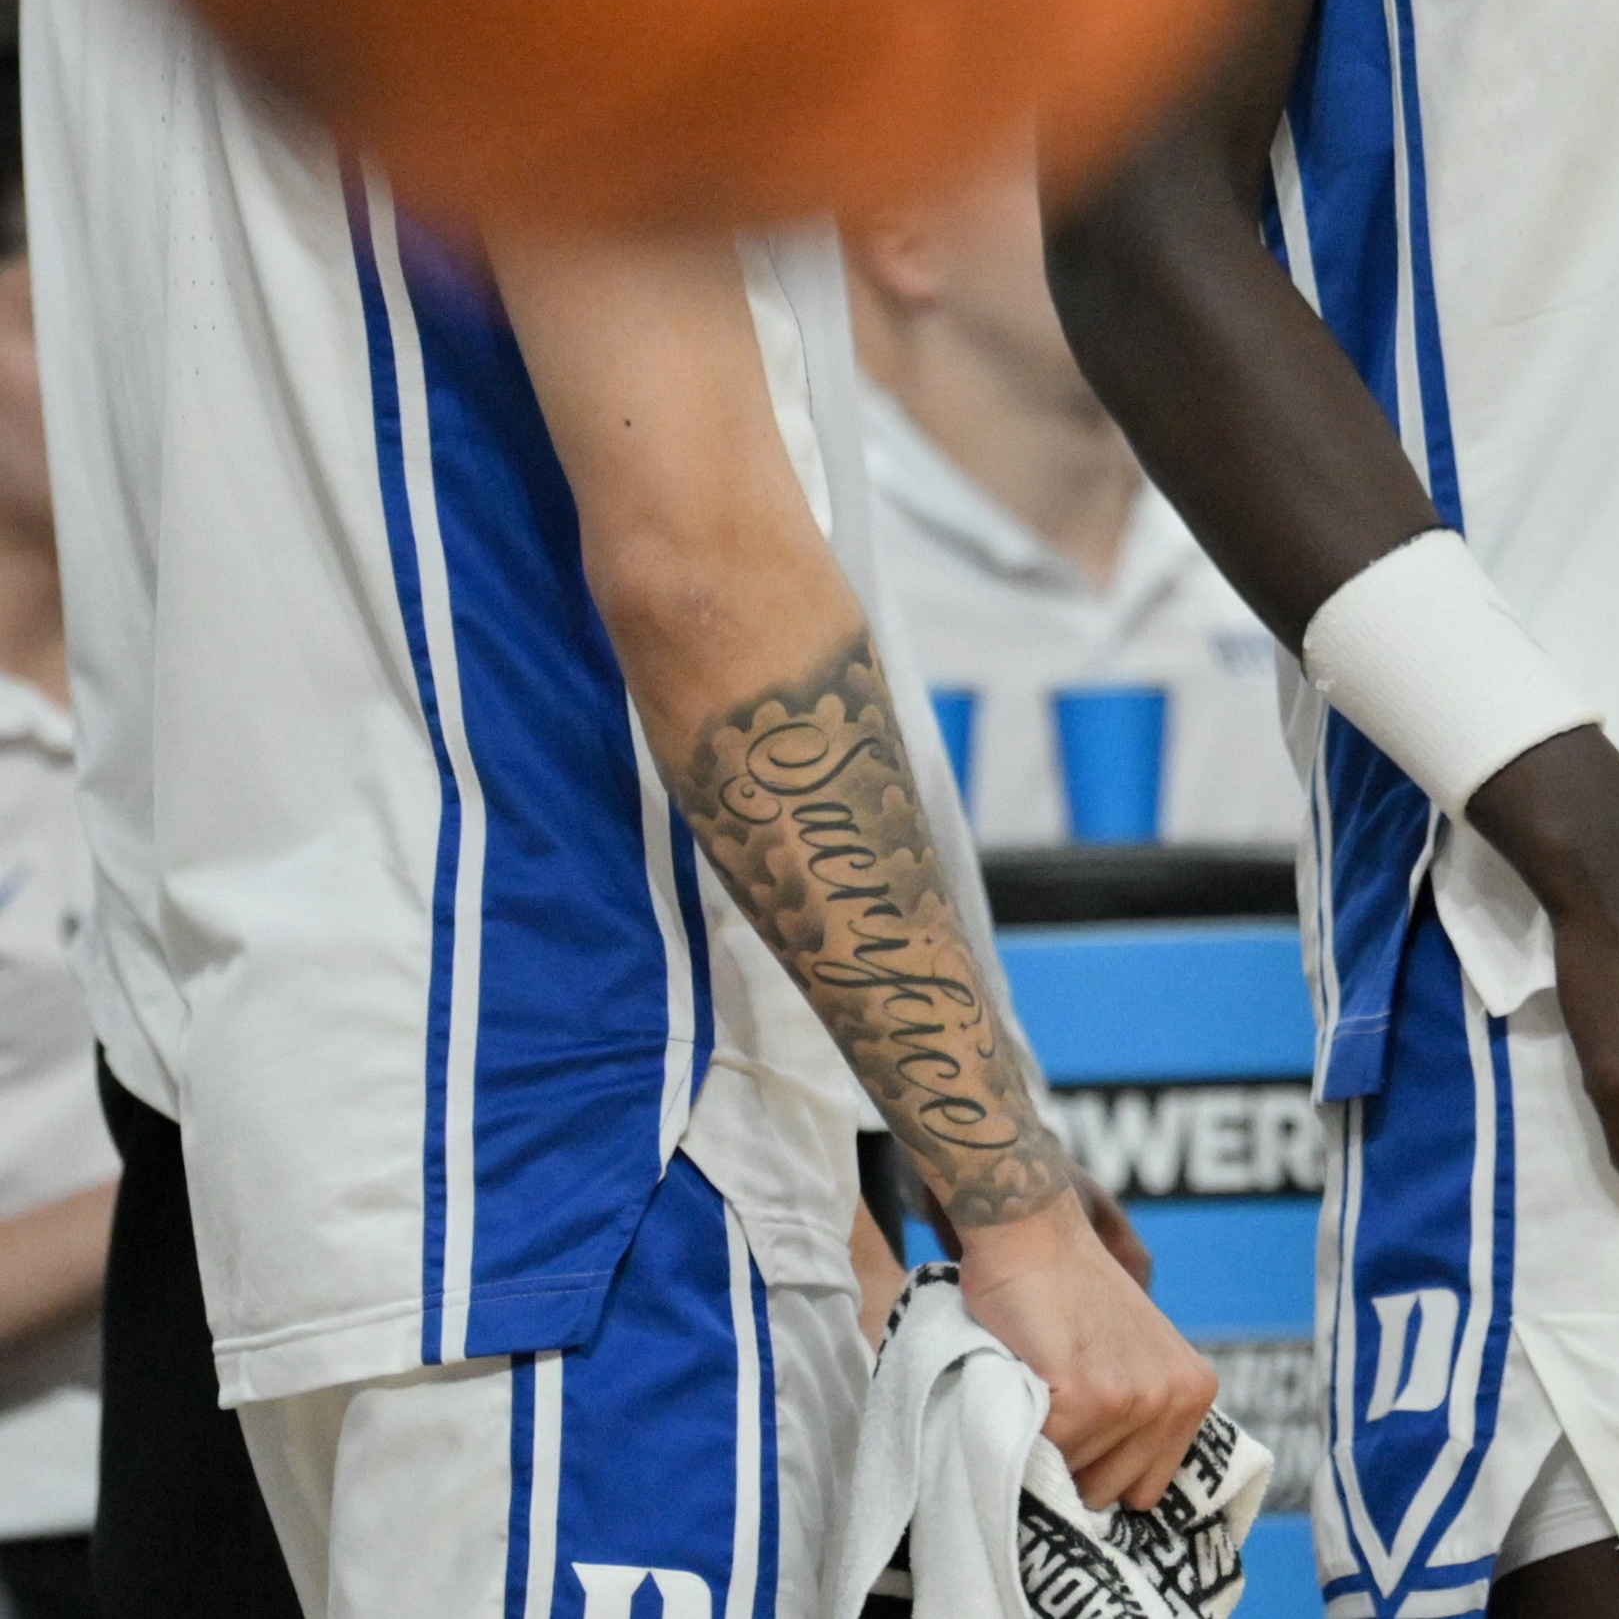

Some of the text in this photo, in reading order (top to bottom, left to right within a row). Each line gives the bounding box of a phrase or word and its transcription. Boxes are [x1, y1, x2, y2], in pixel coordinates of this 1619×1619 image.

[718, 721, 1020, 1150] Sacrifice
[1042, 1085, 1326, 1196] WER
[1366, 1287, 1460, 1422] D
